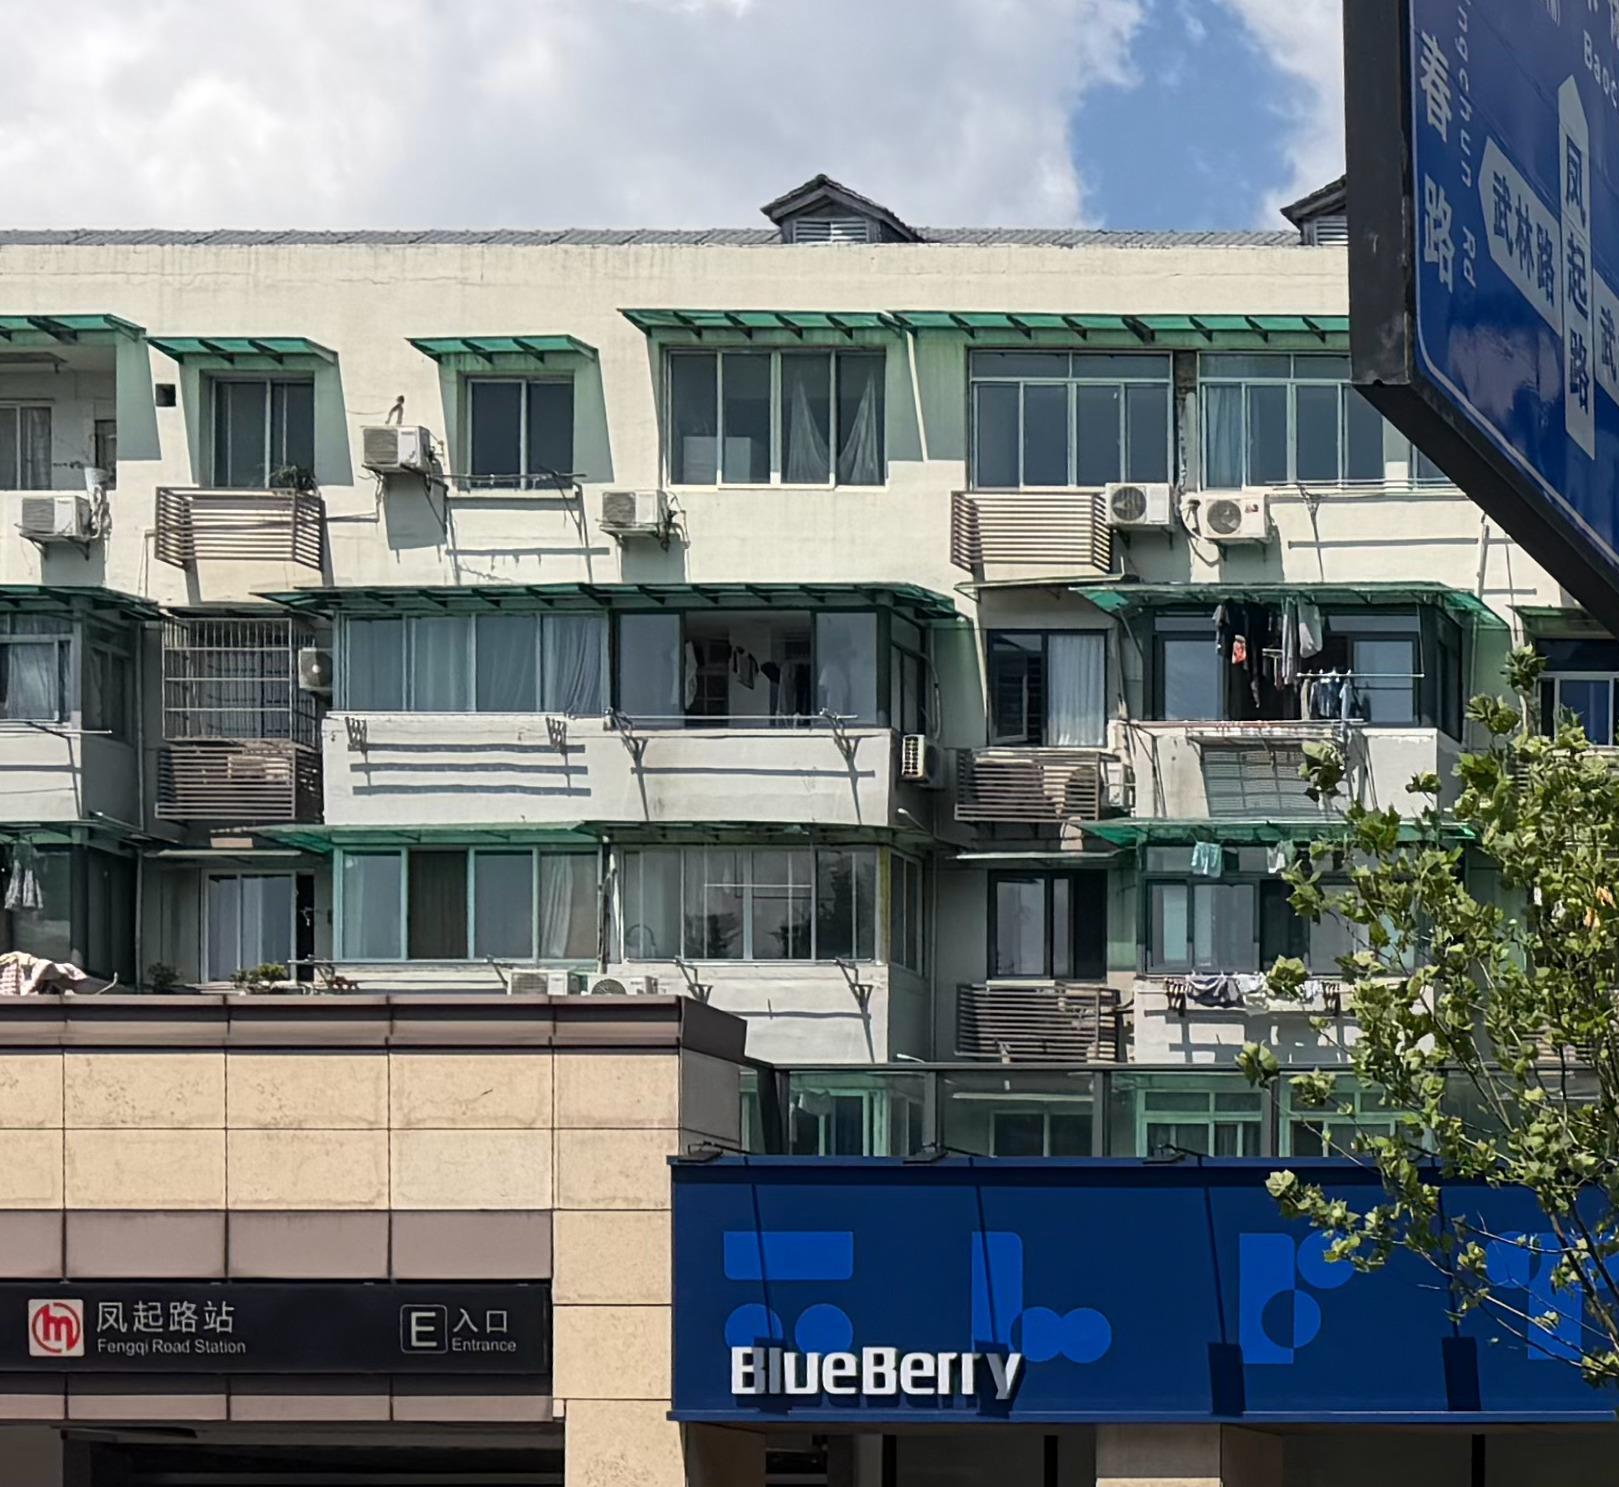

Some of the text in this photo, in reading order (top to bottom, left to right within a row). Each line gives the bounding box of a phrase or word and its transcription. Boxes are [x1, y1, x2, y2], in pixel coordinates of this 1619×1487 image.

[1492, 171, 1555, 308] 武林路
[1463, 226, 1477, 289] Rd
[1566, 133, 1589, 417] 凤起路
[97, 1300, 235, 1333] 凤起路站
[411, 1312, 437, 1347] E
[453, 1308, 507, 1333] 入口
[97, 1338, 246, 1356] Fengqi Road Station
[452, 1337, 517, 1352] Entrance
[731, 1346, 1021, 1399] BlueBerry
